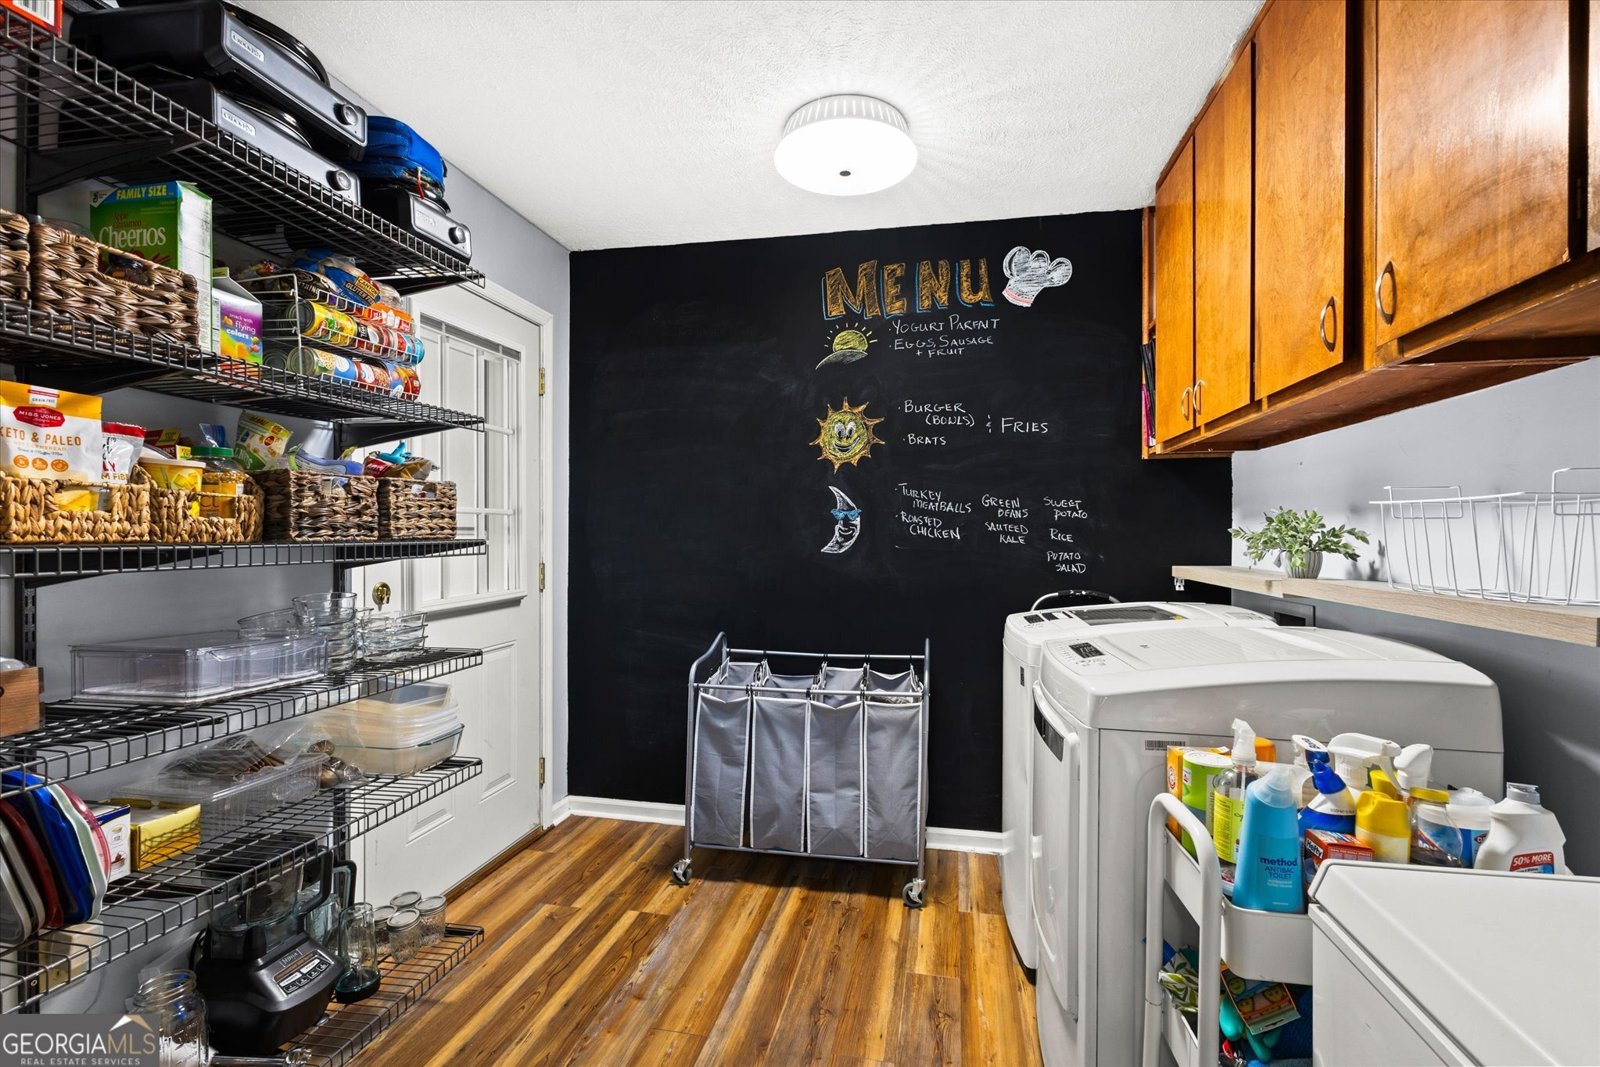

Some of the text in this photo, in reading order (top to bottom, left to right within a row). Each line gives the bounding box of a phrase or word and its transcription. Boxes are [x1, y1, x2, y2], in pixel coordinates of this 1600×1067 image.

[116, 184, 167, 200] FAMILY SIZE
[99, 225, 167, 249] Cheerios
[822, 258, 996, 320] MENU
[235, 320, 256, 335] flying
[892, 314, 1000, 335] YOGURT PARFAIT
[226, 328, 250, 340] colors
[939, 334, 994, 349] SAUSAGE
[928, 347, 965, 358] FRUIT
[904, 399, 967, 413] BURGER
[18, 410, 39, 418] MISS
[40, 413, 62, 421] JONES
[1001, 417, 1049, 434] FRIES
[31, 431, 40, 443] &
[45, 433, 82, 447] PALEO
[907, 433, 947, 446] BRATS
[898, 482, 942, 501] TURKEY
[912, 498, 972, 514] MEATBALLS
[981, 493, 1021, 509] GREEN
[1043, 496, 1083, 510] SWEET
[900, 510, 942, 528] ROASTED
[1054, 509, 1088, 521] POTATO
[909, 524, 961, 540] CHICKEN
[984, 521, 1029, 535] SAUTEED
[1049, 528, 1074, 543] RICE
[999, 533, 1026, 545] KALE
[1046, 551, 1081, 562] POTATO
[1055, 562, 1087, 574] SALAD
[1306, 839, 1323, 858] Hefty
[1260, 857, 1298, 867] method
[1512, 854, 1552, 867] 50% MORE
[1269, 872, 1292, 880] TOILET
